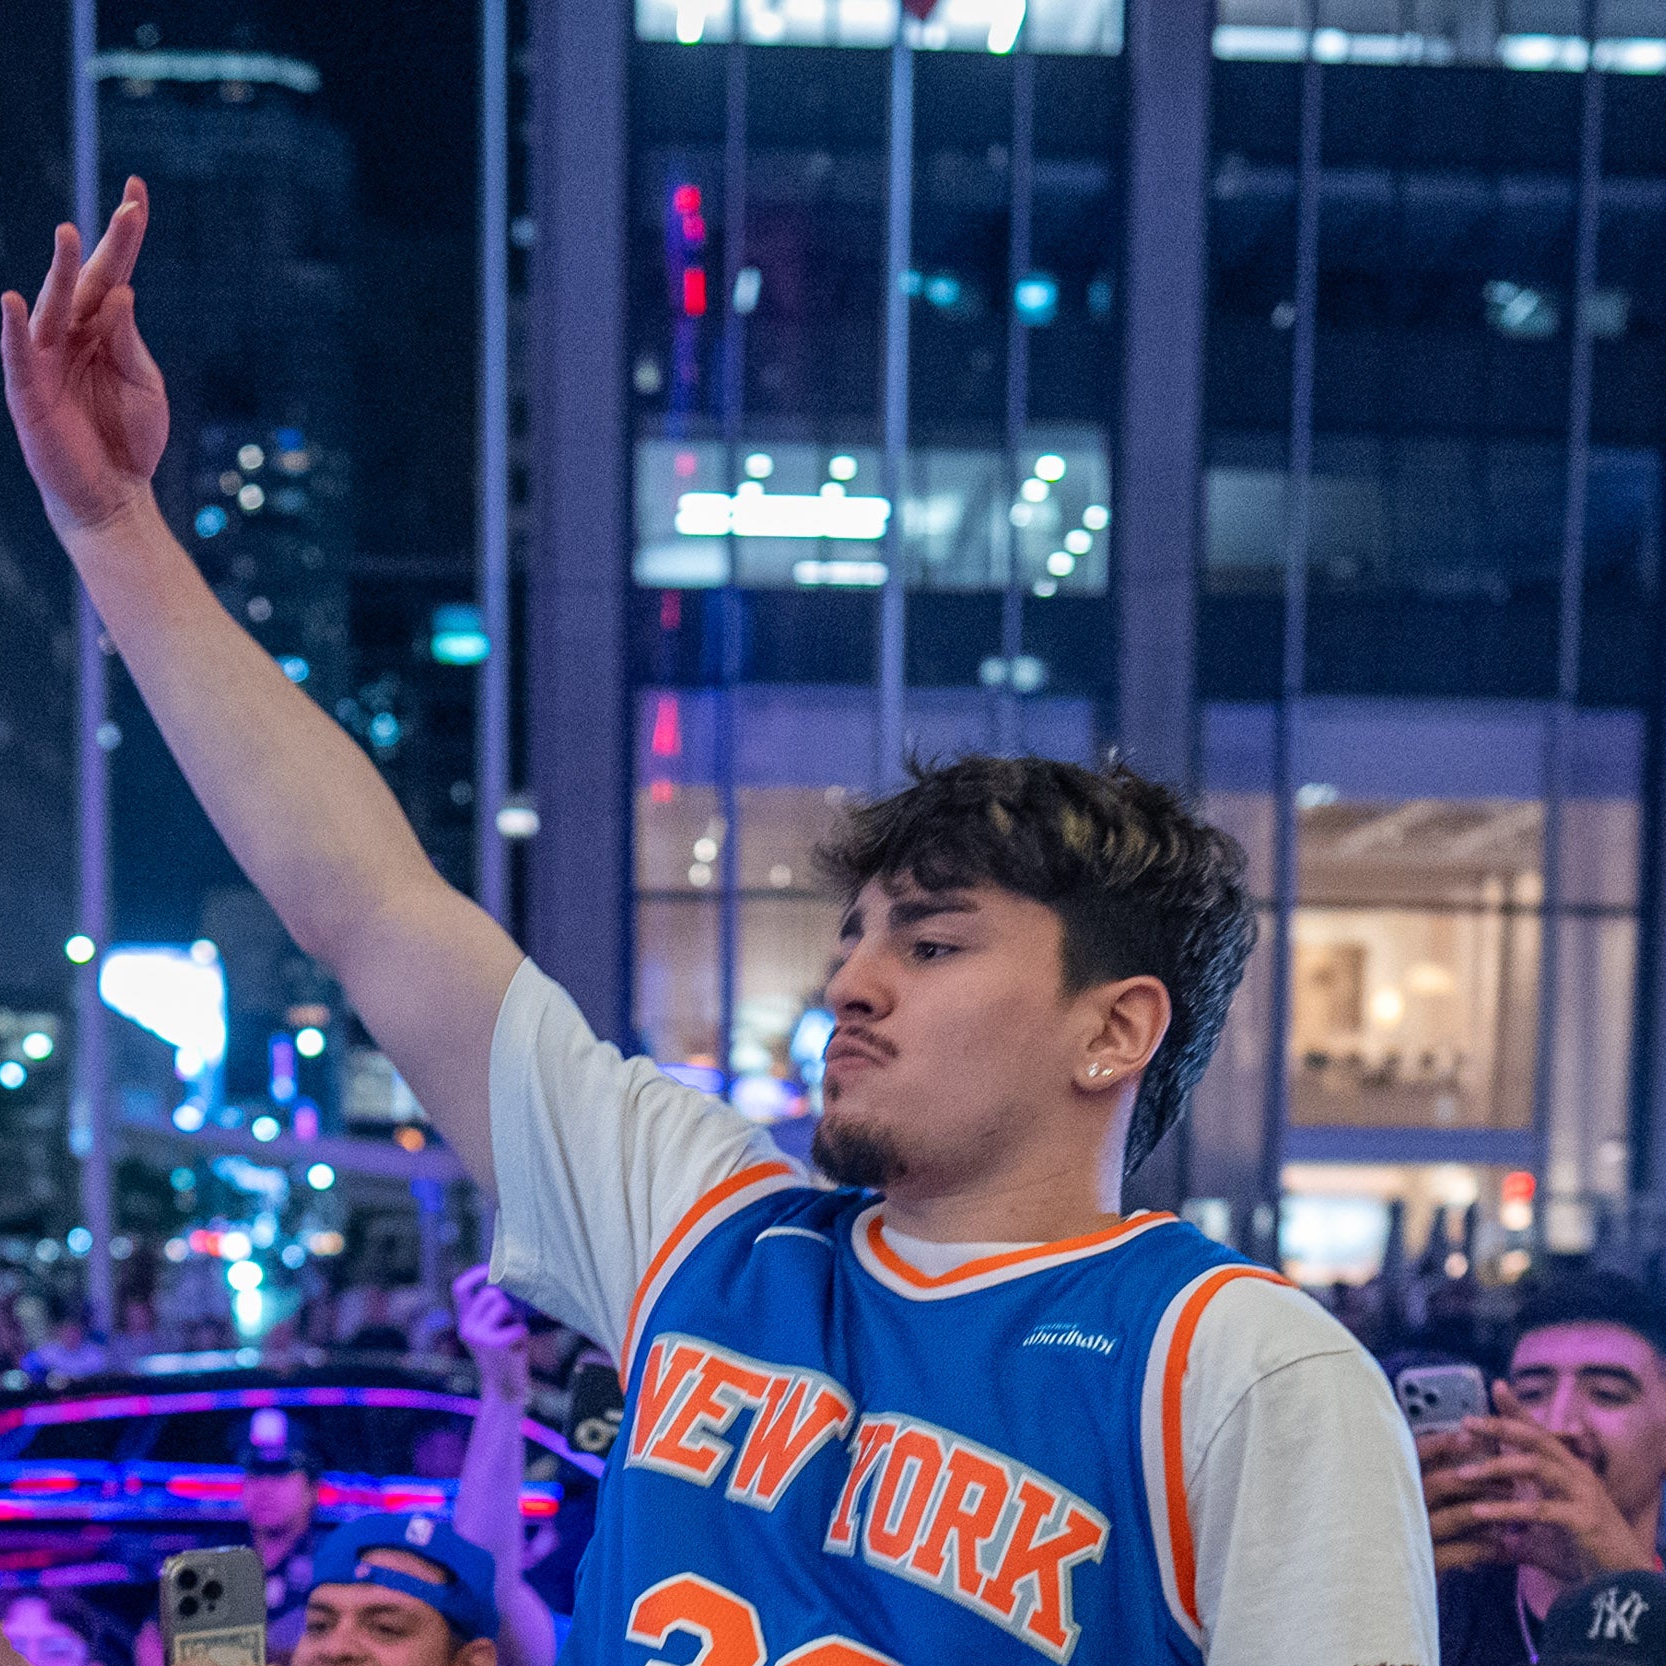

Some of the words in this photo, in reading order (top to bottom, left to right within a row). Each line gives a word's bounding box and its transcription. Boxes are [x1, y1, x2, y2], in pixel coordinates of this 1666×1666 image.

[624, 1331, 856, 1512] NEW
[822, 1412, 1110, 1666] YORK
[1586, 1585, 1649, 1644] NY
